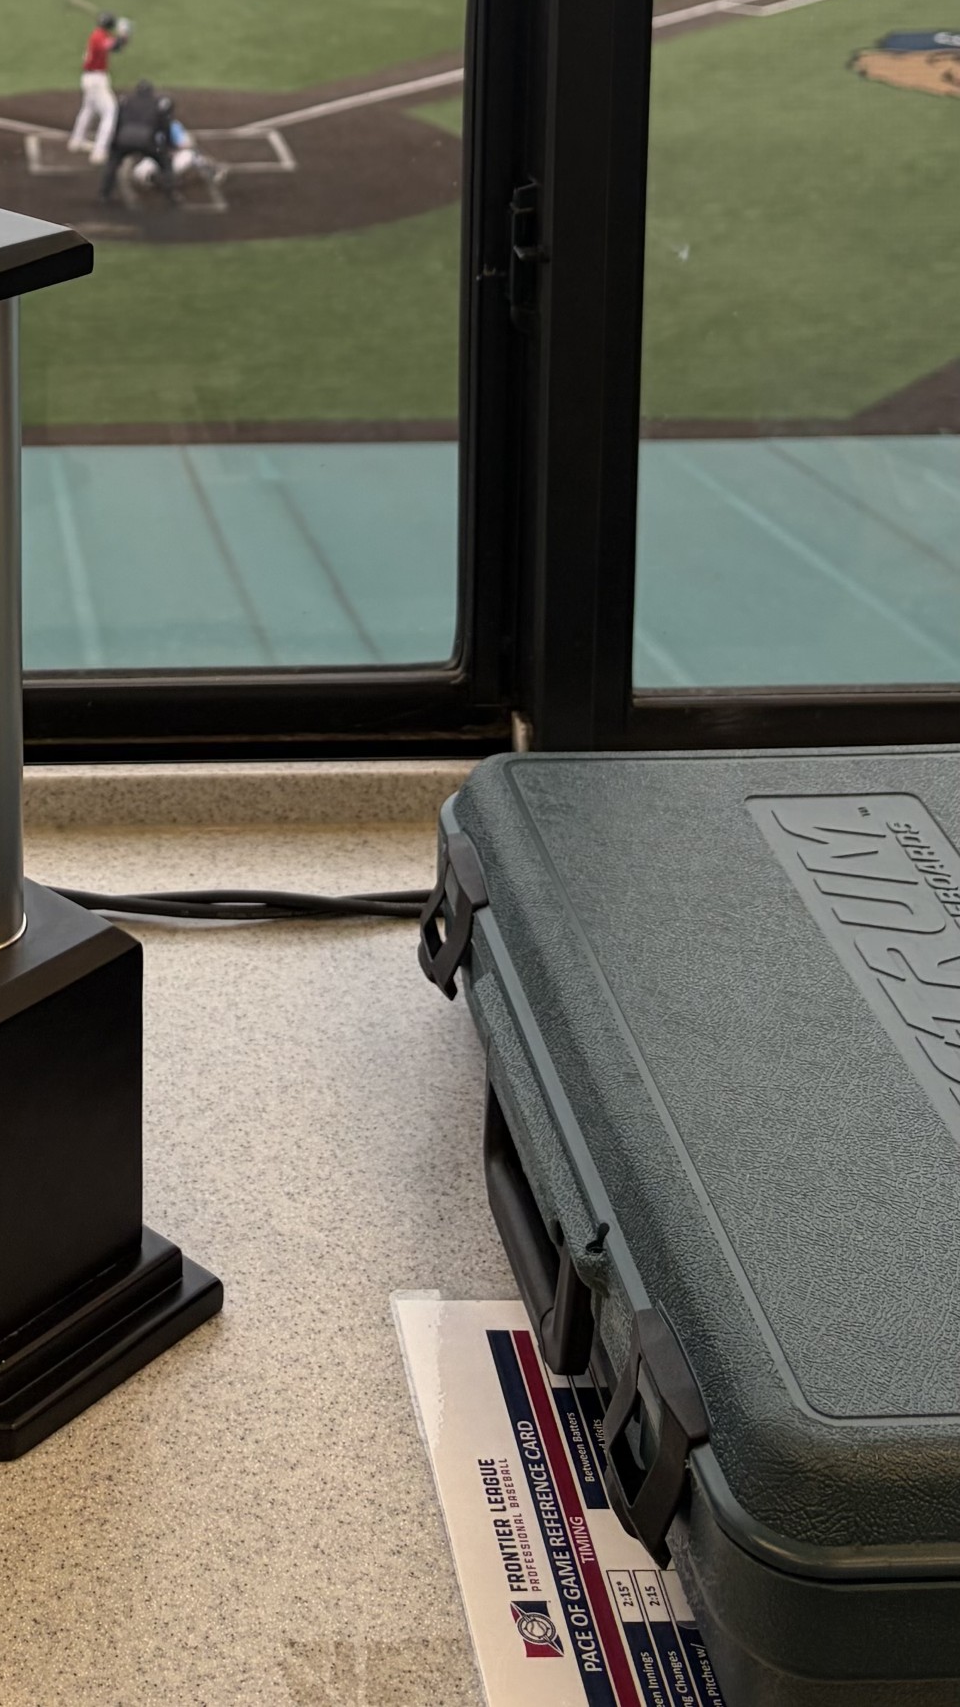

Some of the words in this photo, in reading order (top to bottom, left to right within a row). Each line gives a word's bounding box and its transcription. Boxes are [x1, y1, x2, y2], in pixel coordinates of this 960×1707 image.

[516, 1420, 542, 1460] CARD
[566, 1412, 583, 1443] Batters
[498, 1458, 520, 1508] BASEBALL
[576, 1443, 595, 1482] Between
[477, 1458, 507, 1512] LEAGUE
[528, 1463, 567, 1547] REFERENCE
[493, 1518, 529, 1592] FRONTIER
[512, 1513, 542, 1592] PROFESSIONAL
[569, 1516, 595, 1564] TIMING
[552, 1550, 581, 1601] GAME
[644, 1585, 661, 1607] 2:15
[567, 1604, 589, 1627] OF
[575, 1630, 603, 1672] PACE
[640, 1651, 660, 1689] Innings
[667, 1650, 688, 1694] Changes
[700, 1659, 720, 1697] Pitches
